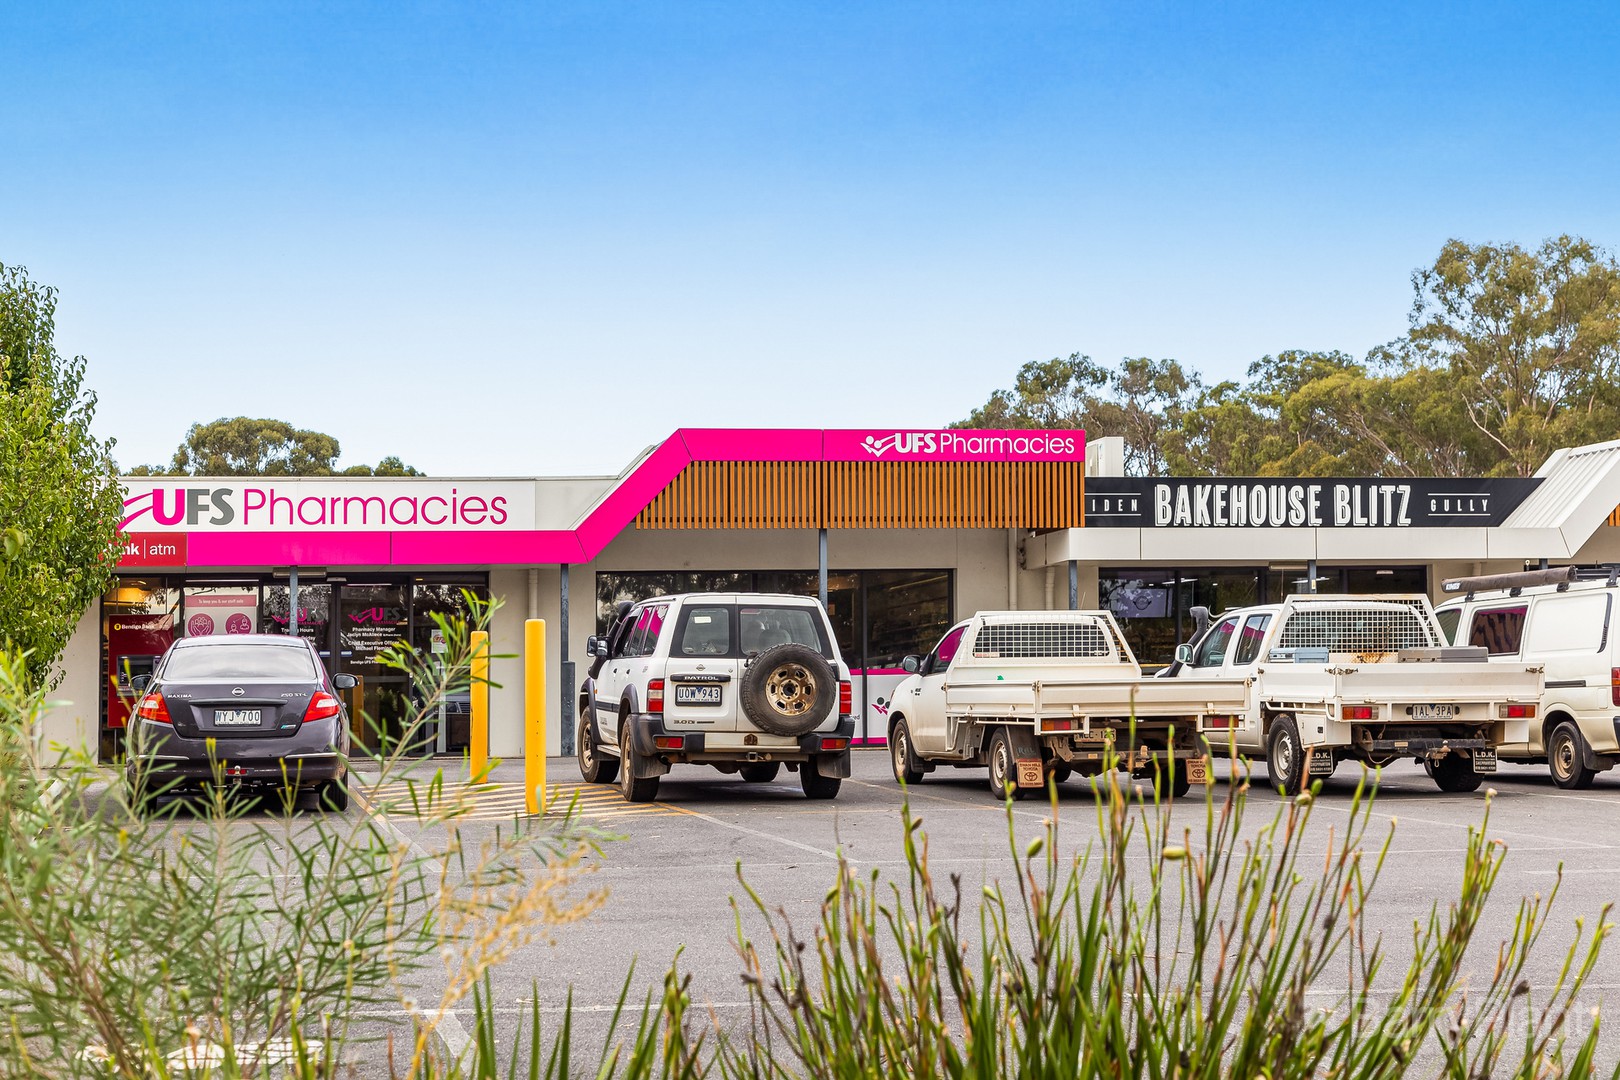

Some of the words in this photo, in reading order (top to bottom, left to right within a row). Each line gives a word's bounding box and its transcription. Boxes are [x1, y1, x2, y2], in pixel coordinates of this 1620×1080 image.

[895, 433, 937, 454] UFS
[940, 433, 1075, 454] Pharmacies
[152, 488, 235, 526] UFS
[243, 488, 508, 526] Pharmacies
[1092, 499, 1139, 512] IDEN
[1154, 484, 1322, 527] BAKEHOUSE
[1333, 484, 1412, 527] BLITZ
[1430, 498, 1490, 513] GULLY
[149, 543, 176, 555] atm
[702, 688, 719, 698] 943
[215, 711, 235, 721] WYJ
[241, 711, 260, 721] 700
[1436, 706, 1452, 716] 3PA
